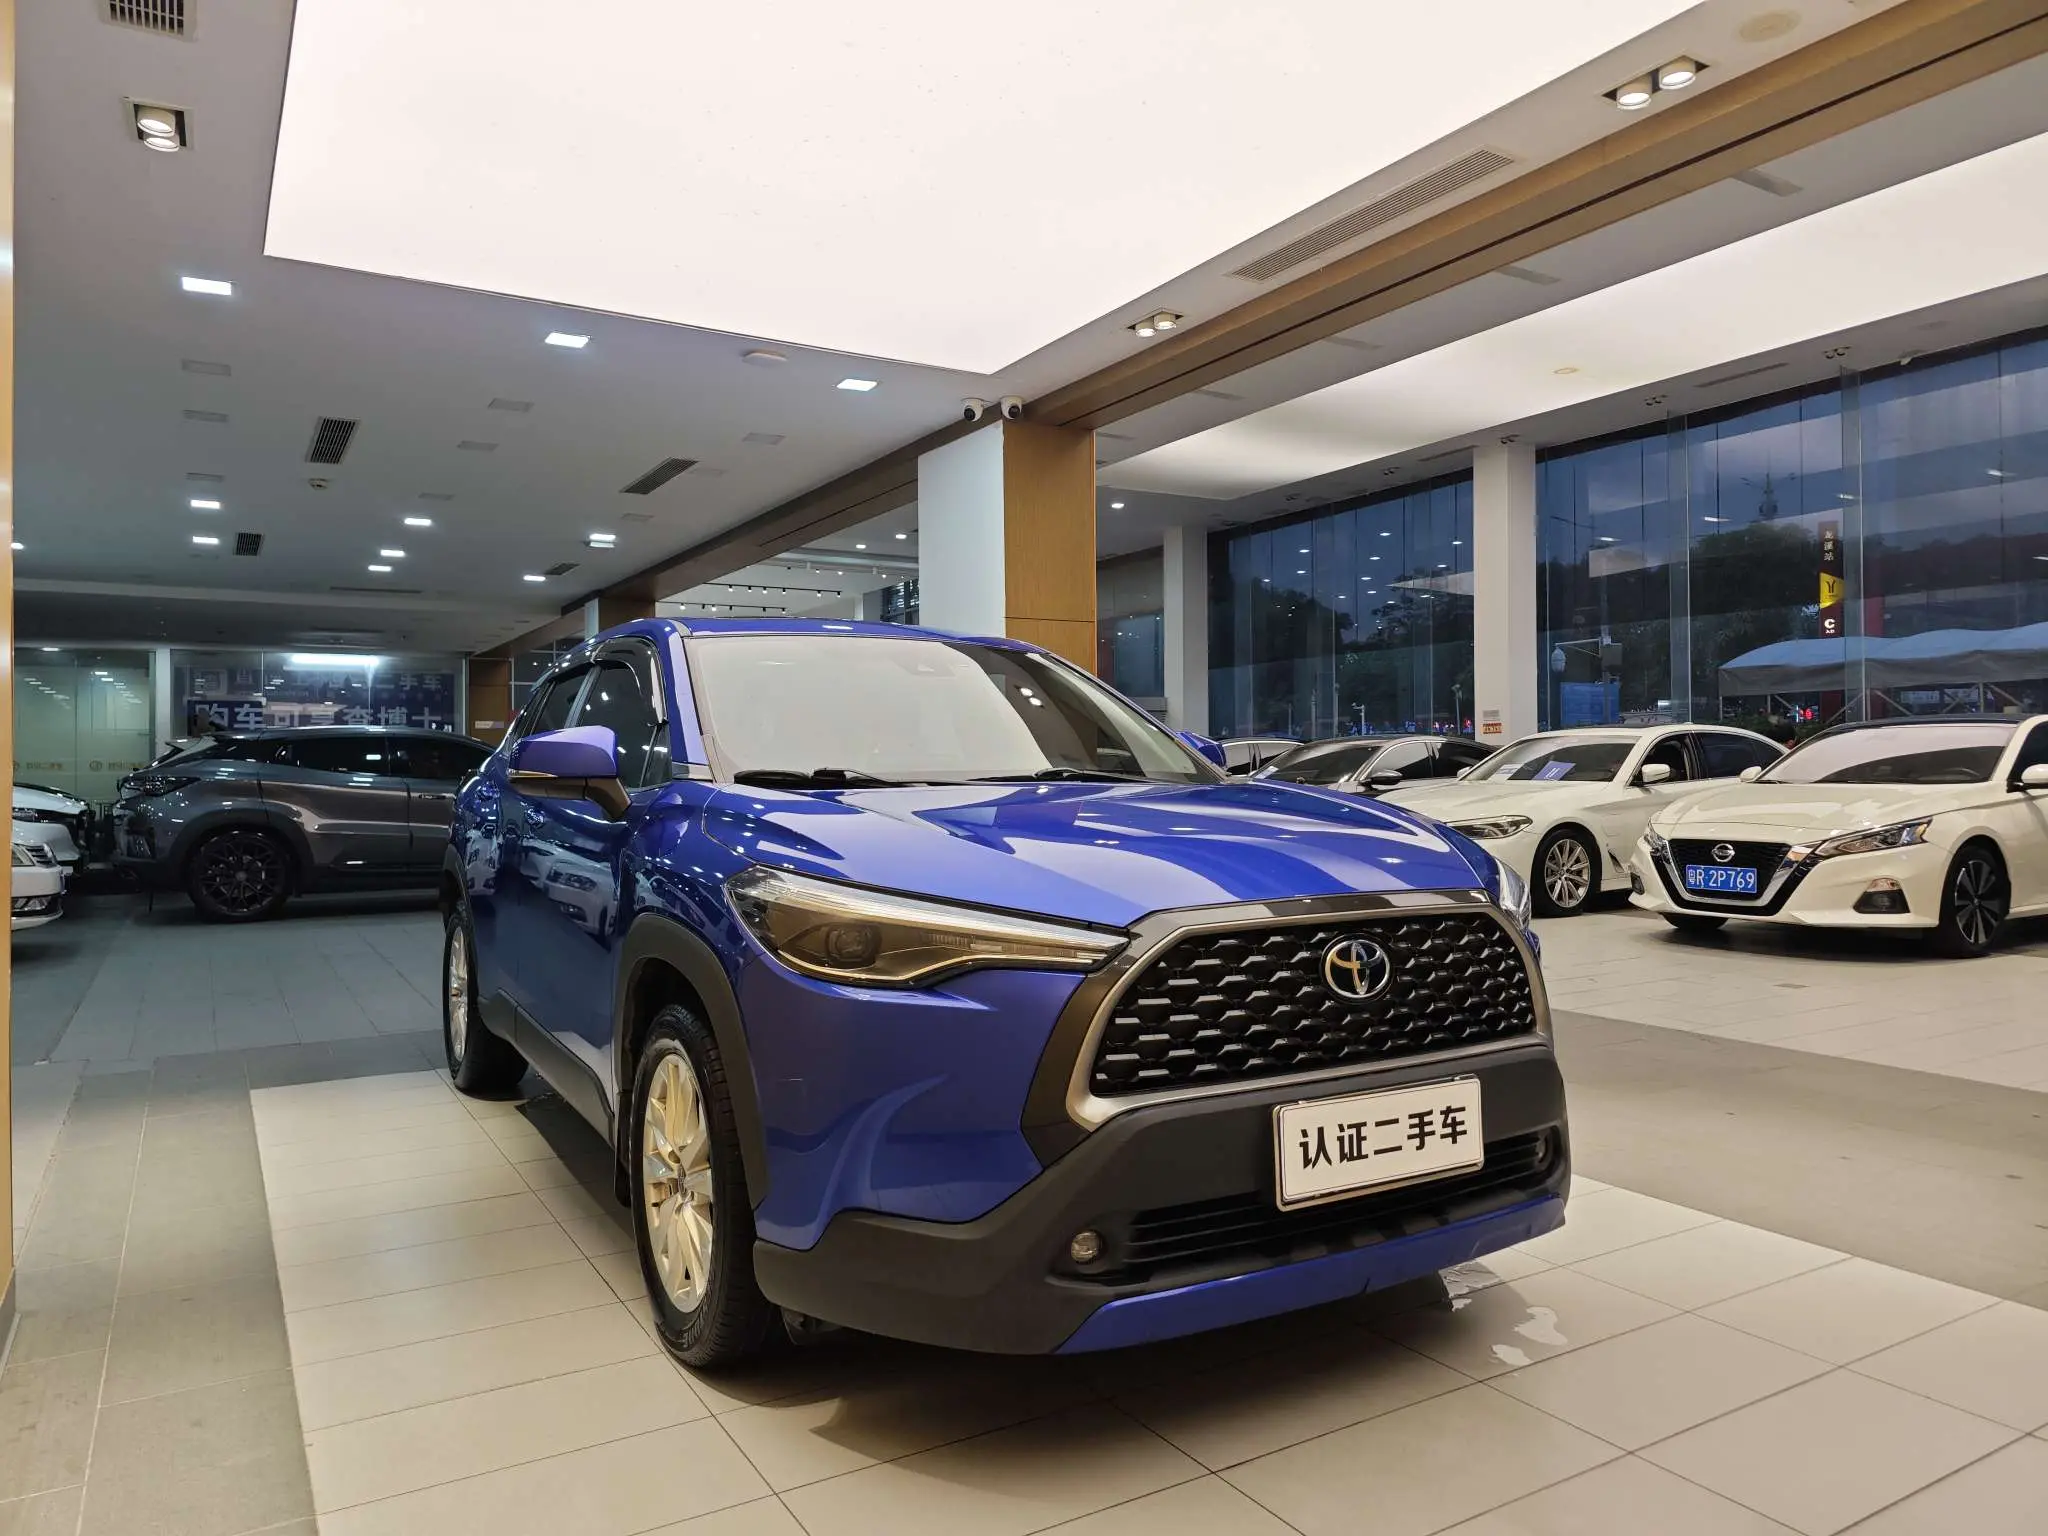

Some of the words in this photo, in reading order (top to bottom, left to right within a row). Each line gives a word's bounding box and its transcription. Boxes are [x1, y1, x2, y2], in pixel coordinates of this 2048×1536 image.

[1824, 619, 1836, 629] C
[1299, 1105, 1468, 1169] 认证二手车
